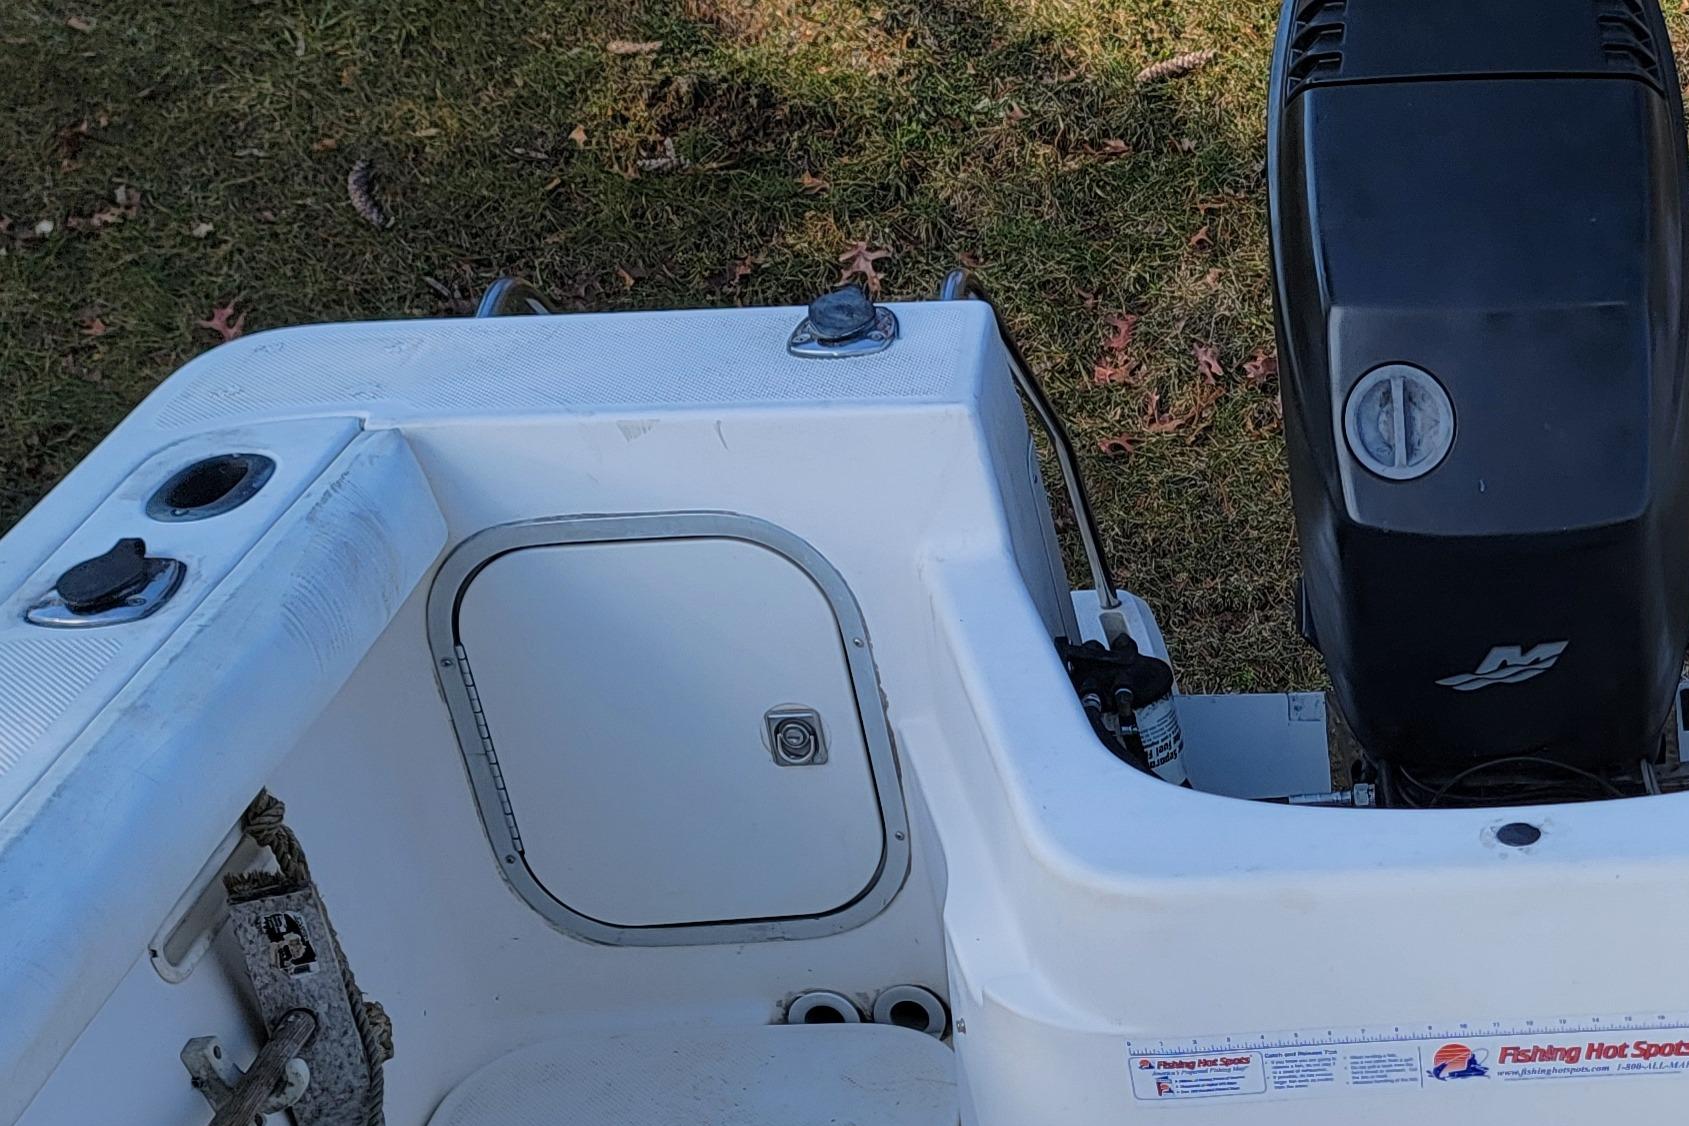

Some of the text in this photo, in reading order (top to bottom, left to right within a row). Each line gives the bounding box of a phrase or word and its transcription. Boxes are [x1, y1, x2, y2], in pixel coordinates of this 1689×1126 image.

[1498, 1045, 1582, 1064] Fishing
[1585, 1042, 1629, 1060] Hot
[1497, 1064, 1610, 1078] www.fishinghotspots.com
